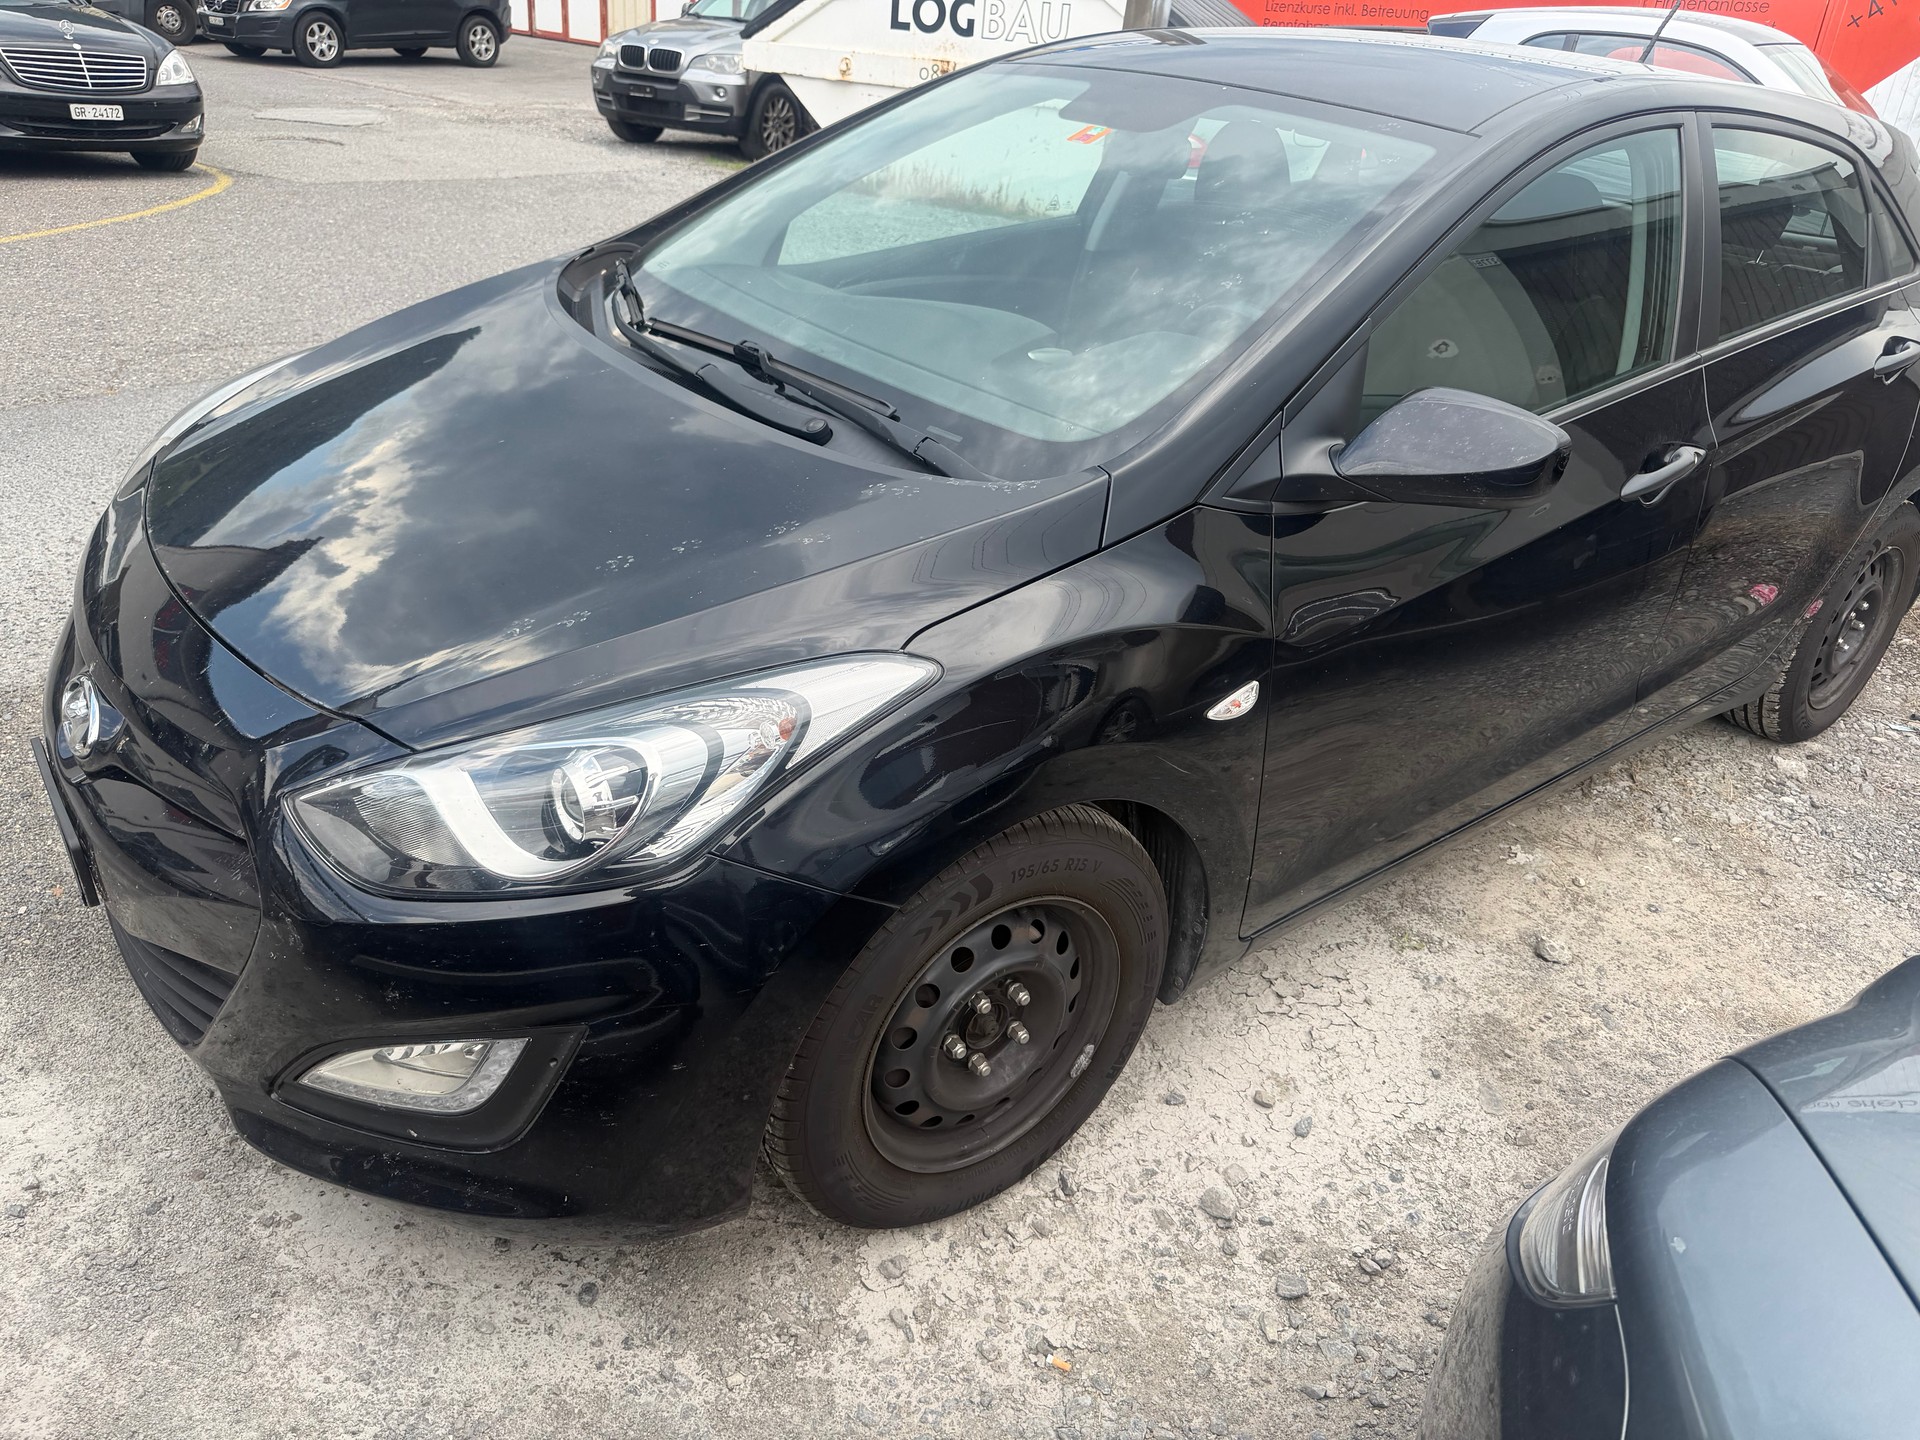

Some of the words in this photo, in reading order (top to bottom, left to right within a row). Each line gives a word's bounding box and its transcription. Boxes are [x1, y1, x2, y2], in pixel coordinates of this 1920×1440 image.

[891, 0, 1071, 43] LOGBAU
[1265, 0, 1331, 14] Lizenzkurse
[1333, 3, 1357, 16] inkl.
[1361, 4, 1429, 22] Betreuung
[1010, 859, 1060, 884] 195/65
[1064, 858, 1088, 873] R15
